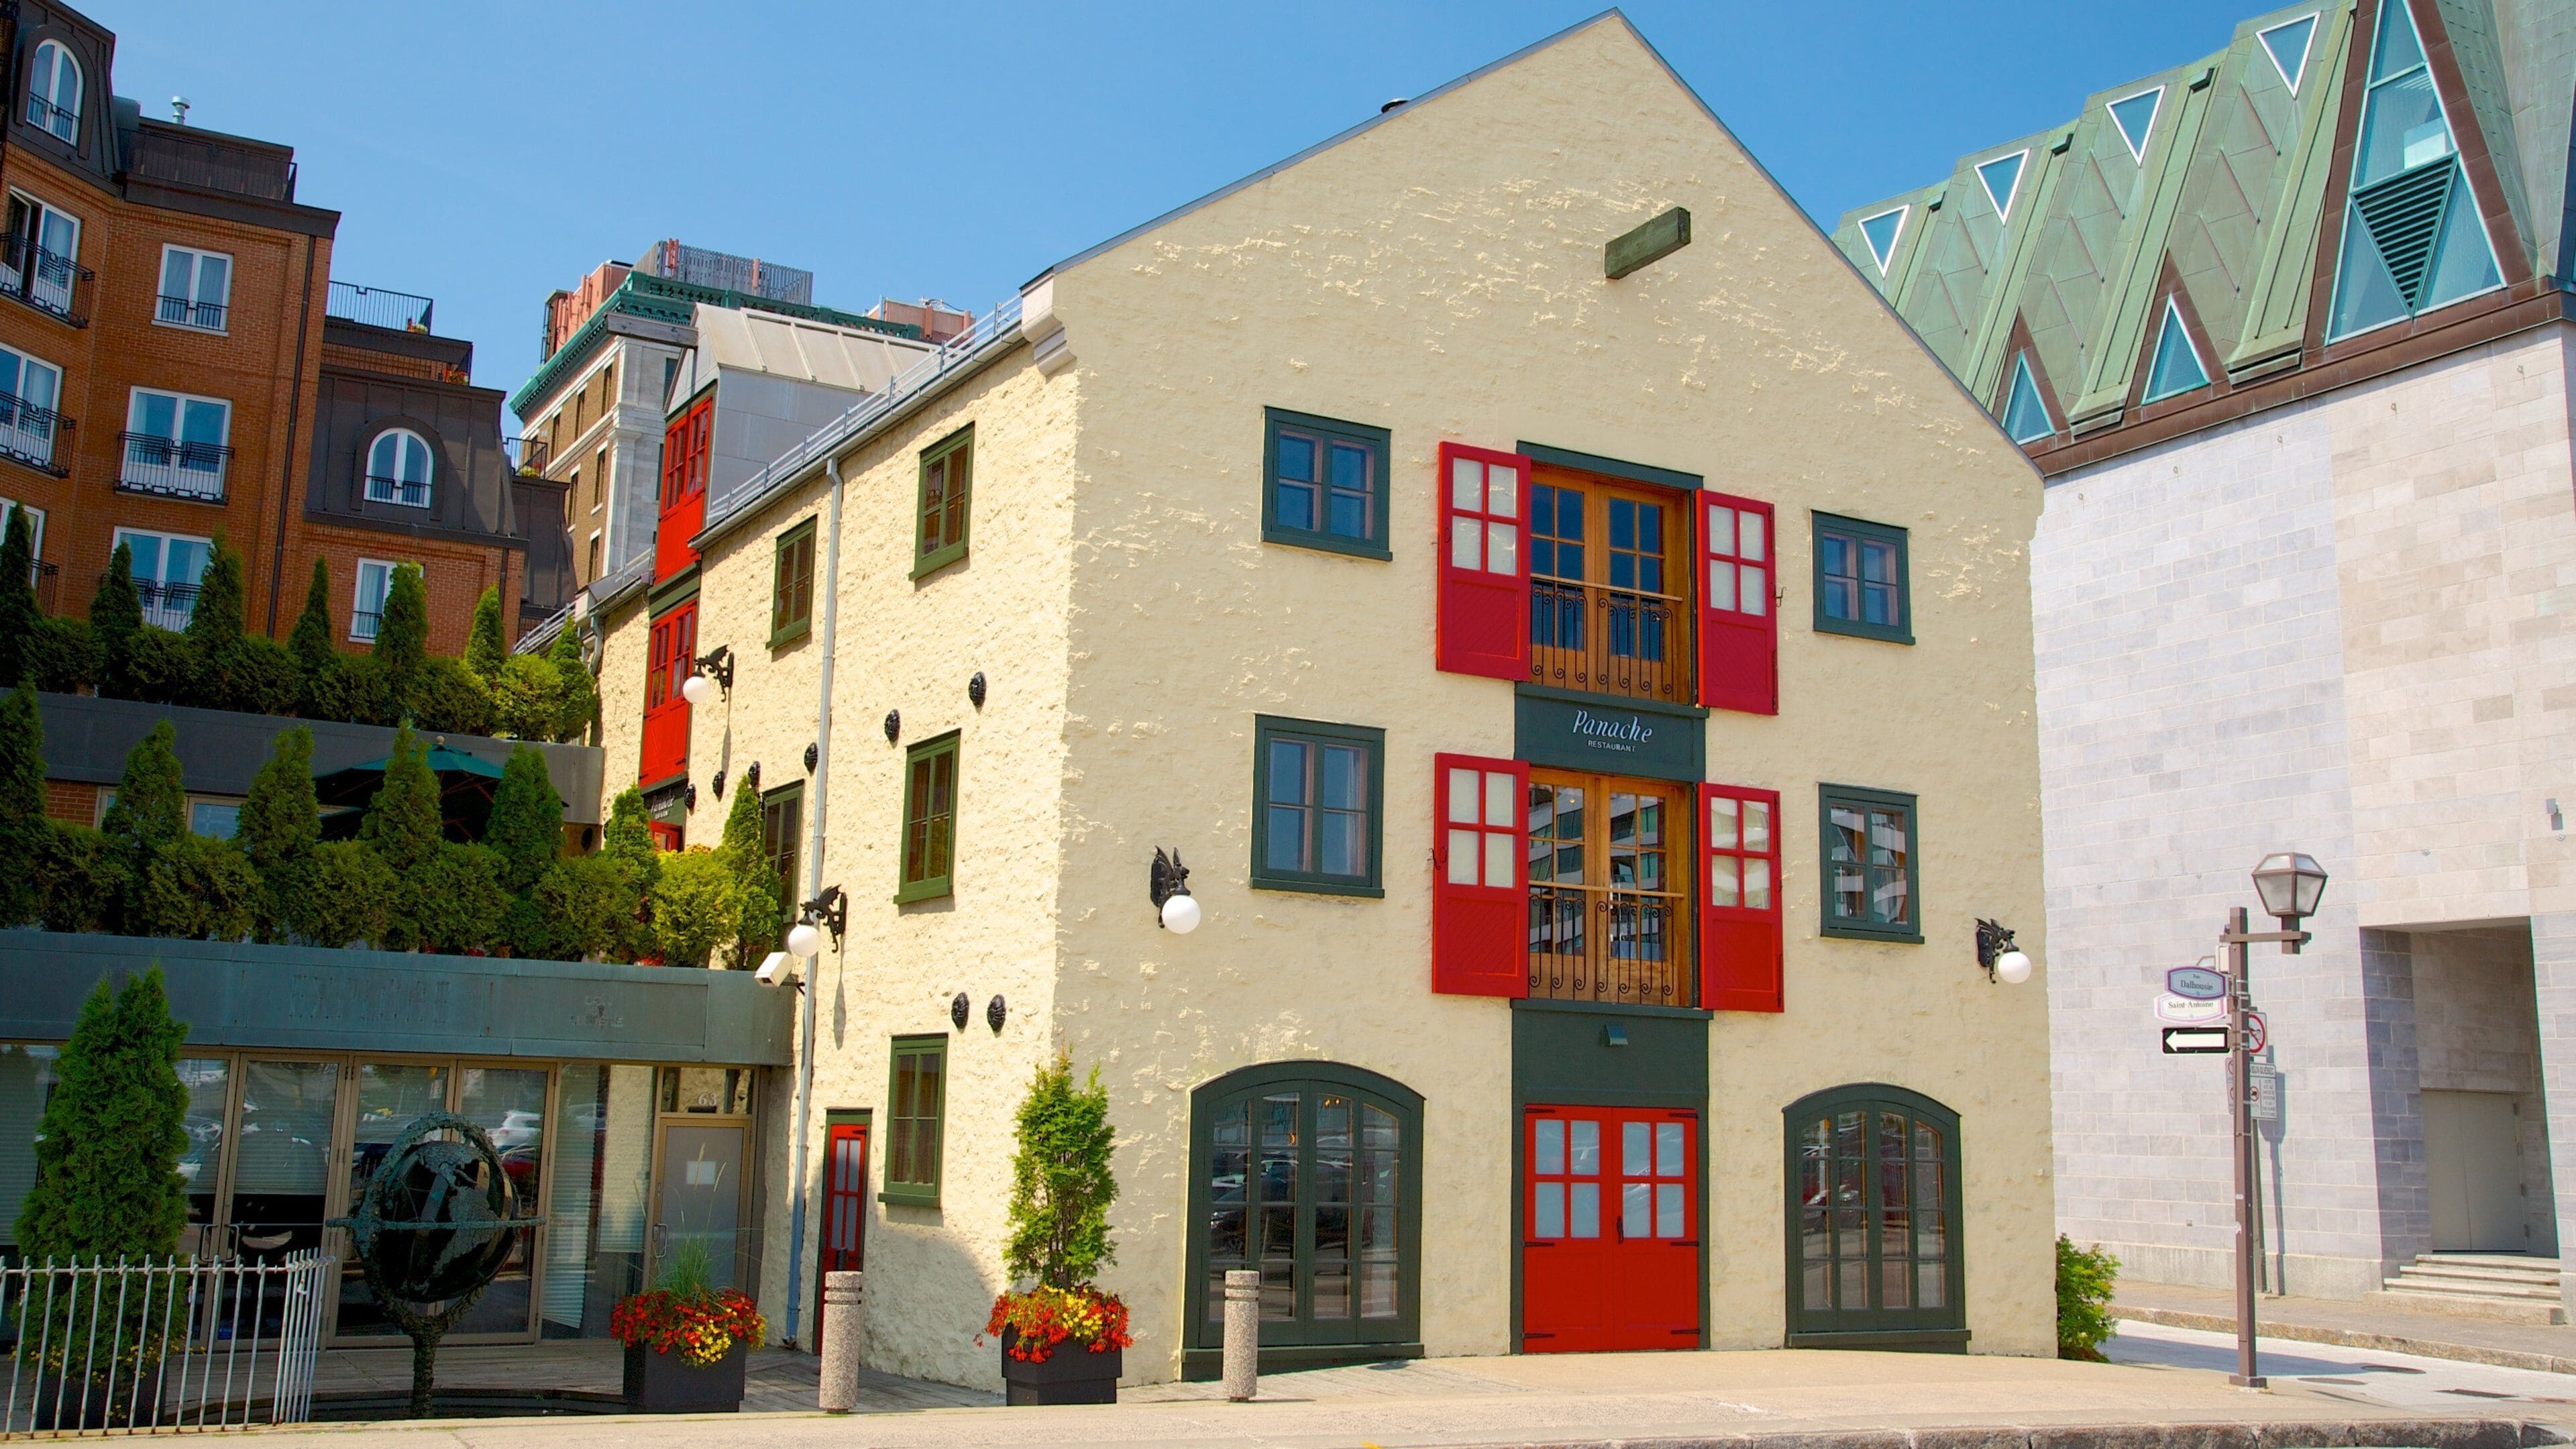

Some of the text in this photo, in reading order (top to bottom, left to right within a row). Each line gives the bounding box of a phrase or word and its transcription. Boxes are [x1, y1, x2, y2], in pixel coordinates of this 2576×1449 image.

[1572, 709, 1653, 743] Panache
[1588, 740, 1635, 752] RESTAURANT
[2180, 979, 2214, 991] Dalhousie
[2167, 1001, 2214, 1009] Saint-Antoine
[698, 1092, 718, 1106] 63
